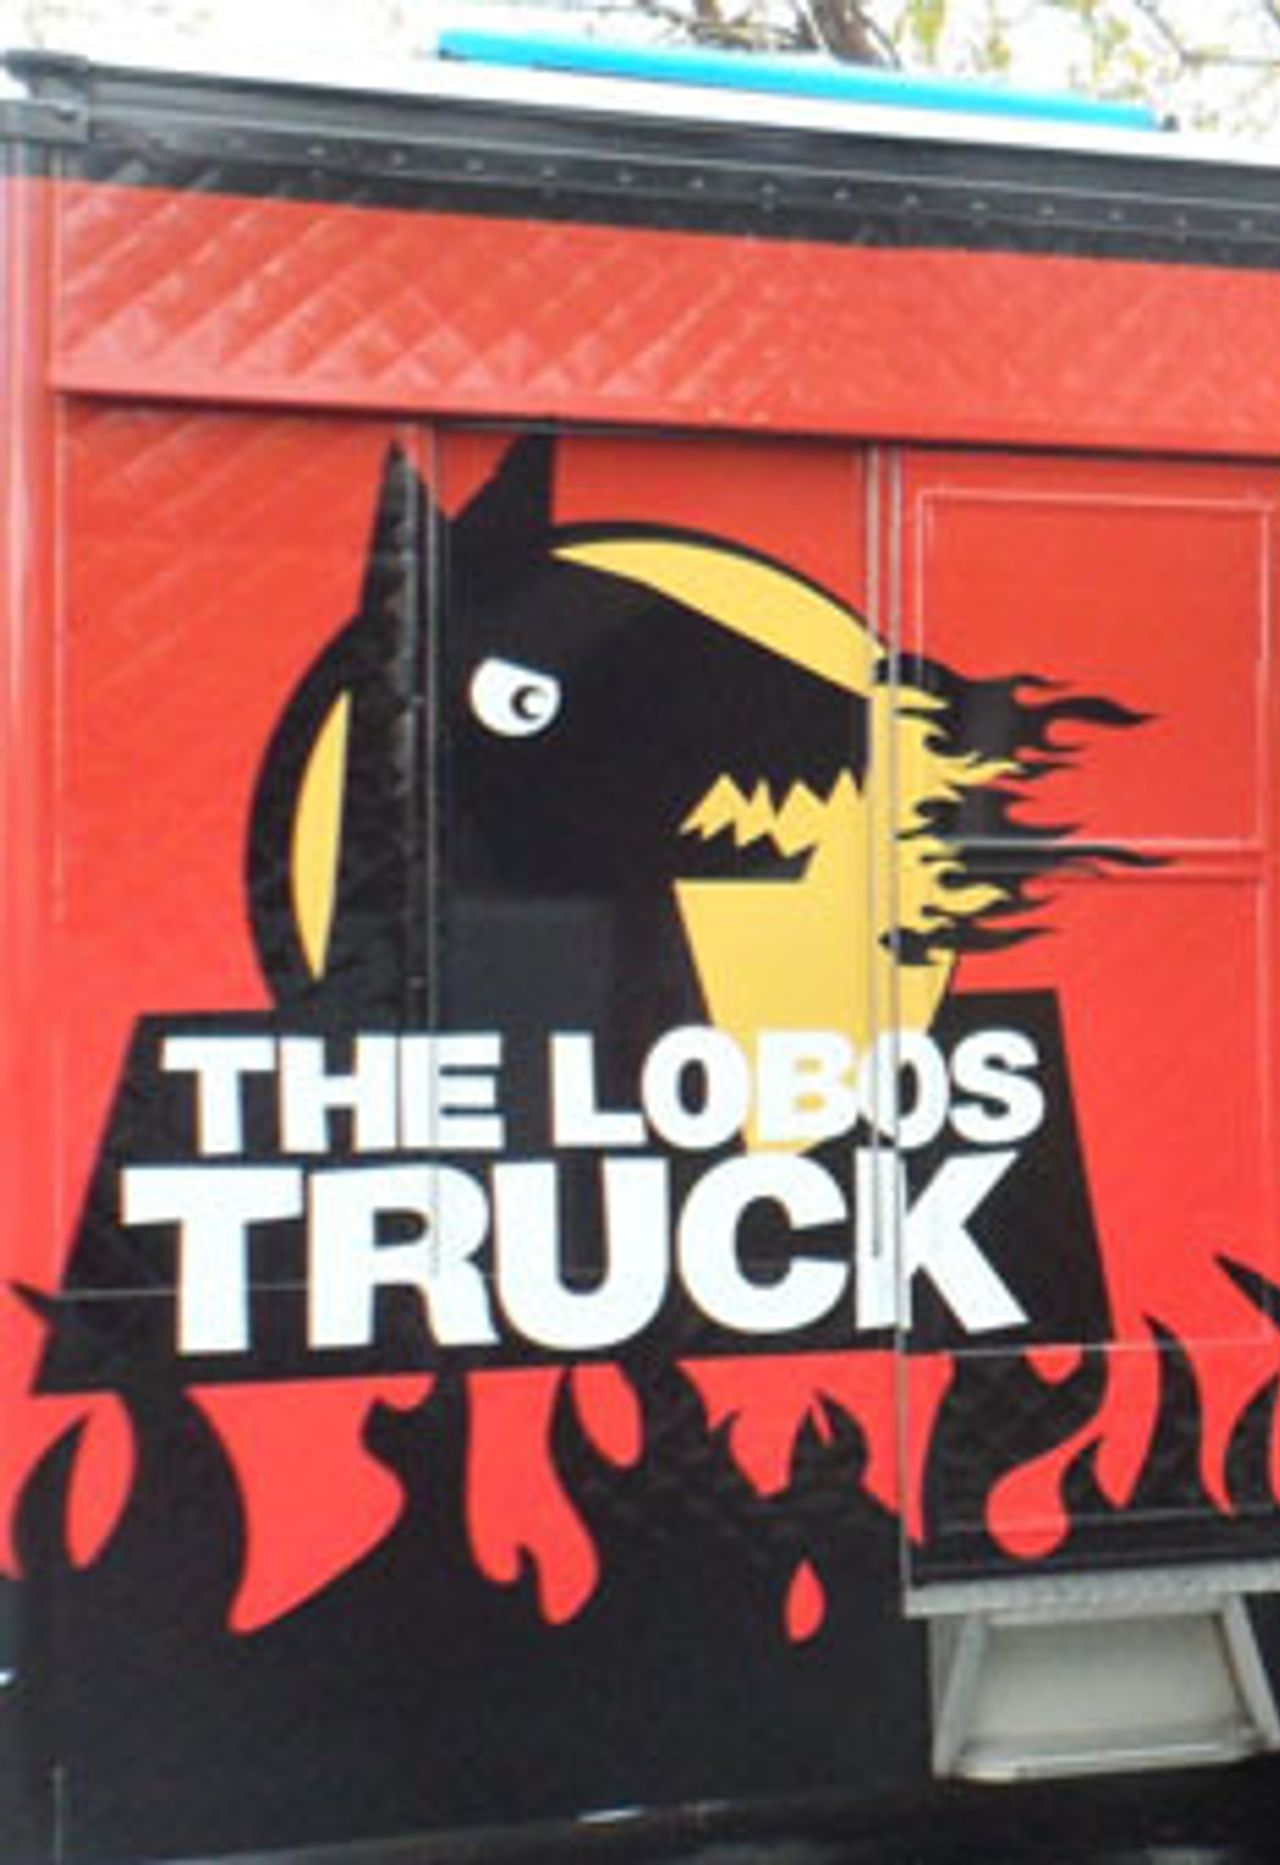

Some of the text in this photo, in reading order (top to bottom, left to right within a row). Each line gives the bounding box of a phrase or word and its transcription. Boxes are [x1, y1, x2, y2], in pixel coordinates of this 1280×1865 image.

[161, 1025, 1048, 1156] THE LOBOS
[120, 1146, 1030, 1355] TRUCK
